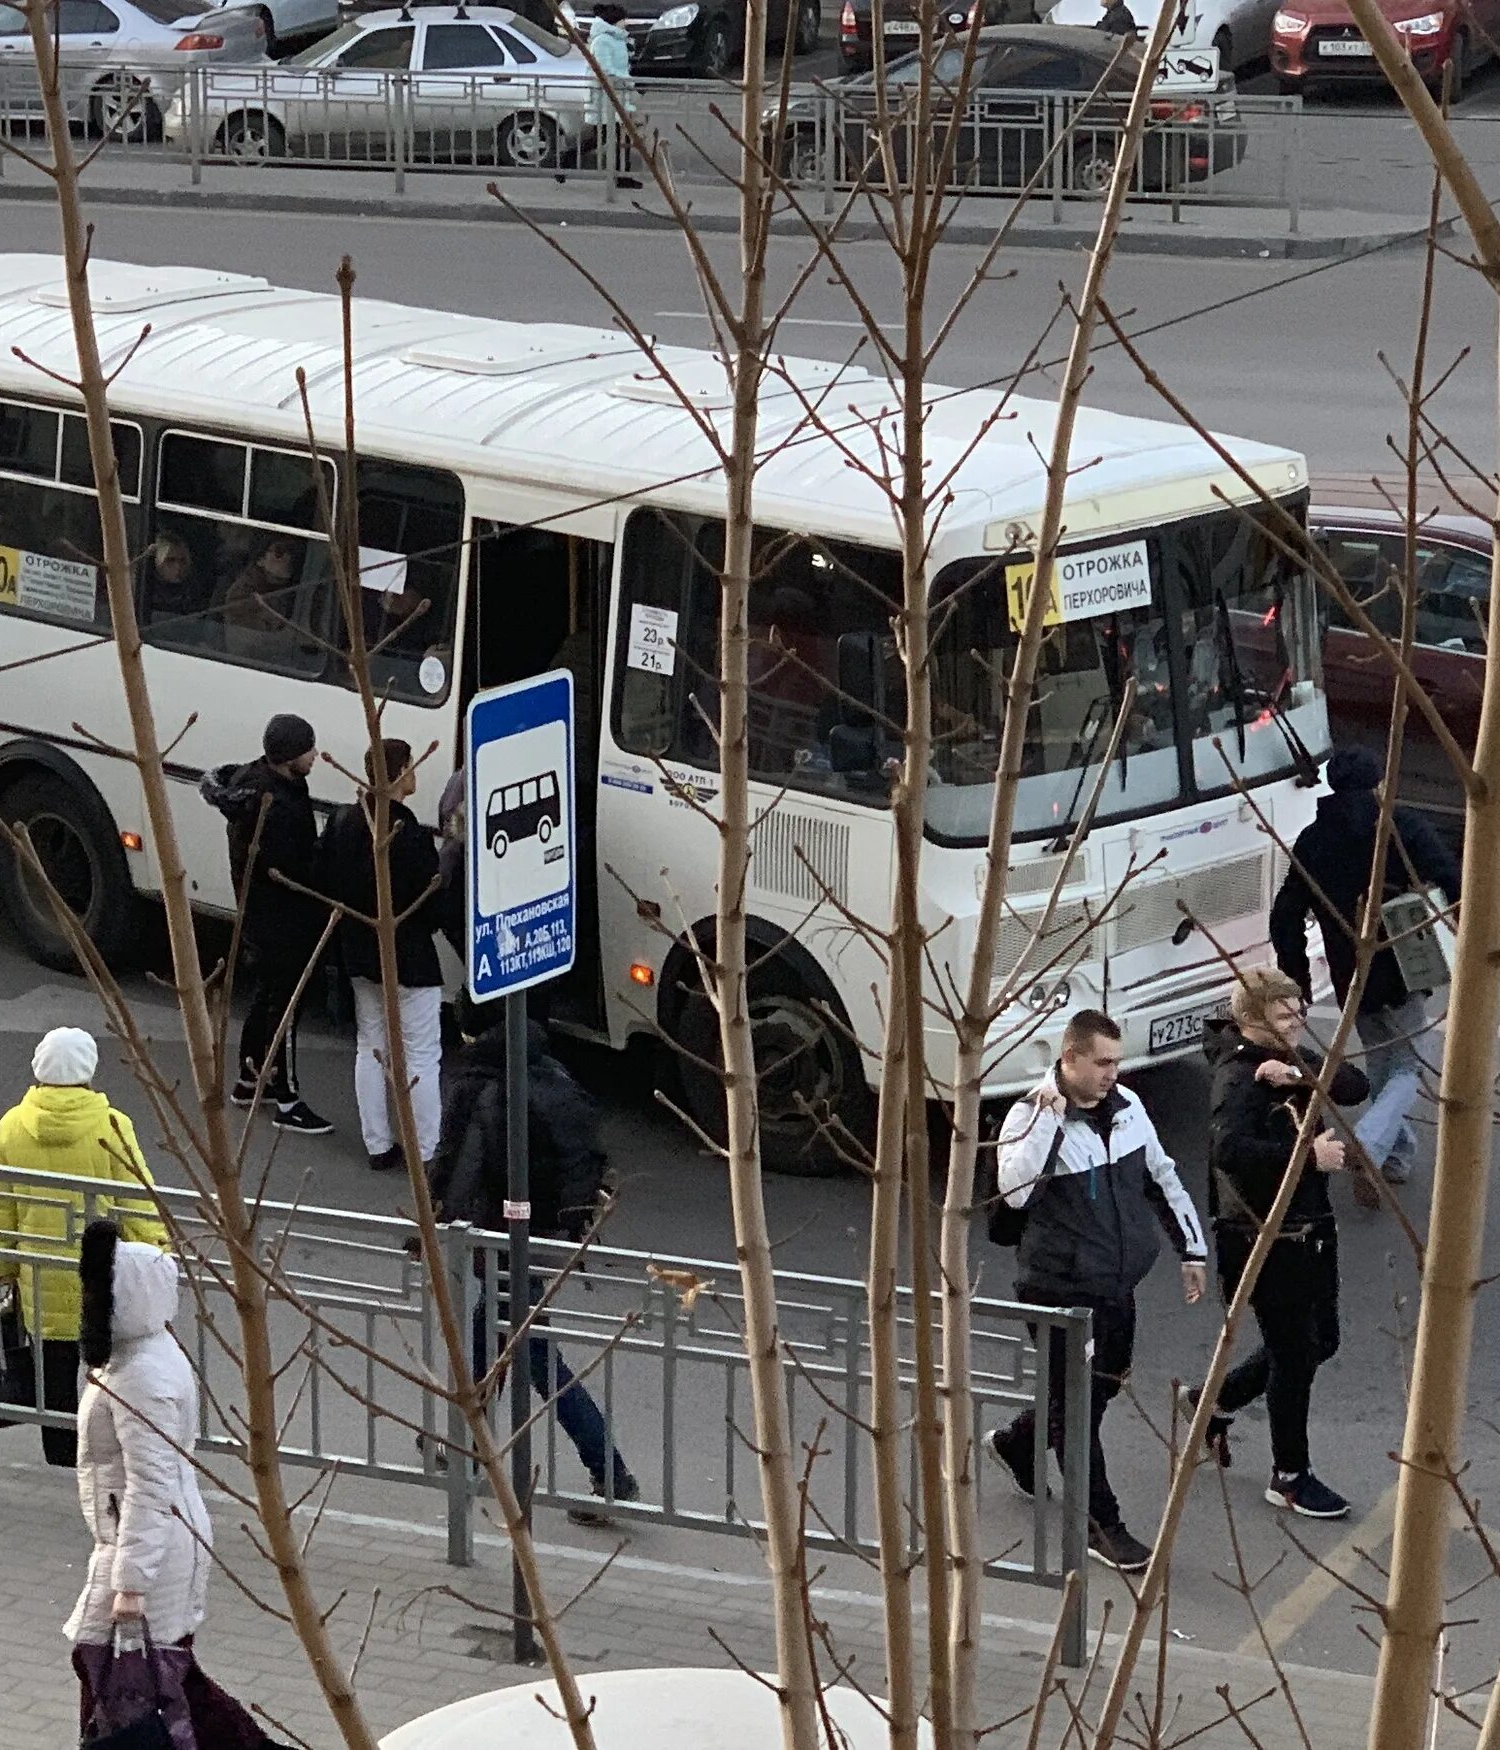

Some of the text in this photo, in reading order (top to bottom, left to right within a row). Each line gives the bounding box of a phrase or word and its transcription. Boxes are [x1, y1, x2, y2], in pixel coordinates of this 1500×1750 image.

[26, 556, 90, 577] ОТРОЖКА
[1063, 550, 1143, 580] ОТРОЖКА
[1063, 579, 1148, 610] ПЕРХОРОВИЧА
[475, 893, 570, 944] ул. Плехановская
[477, 953, 493, 981] А
